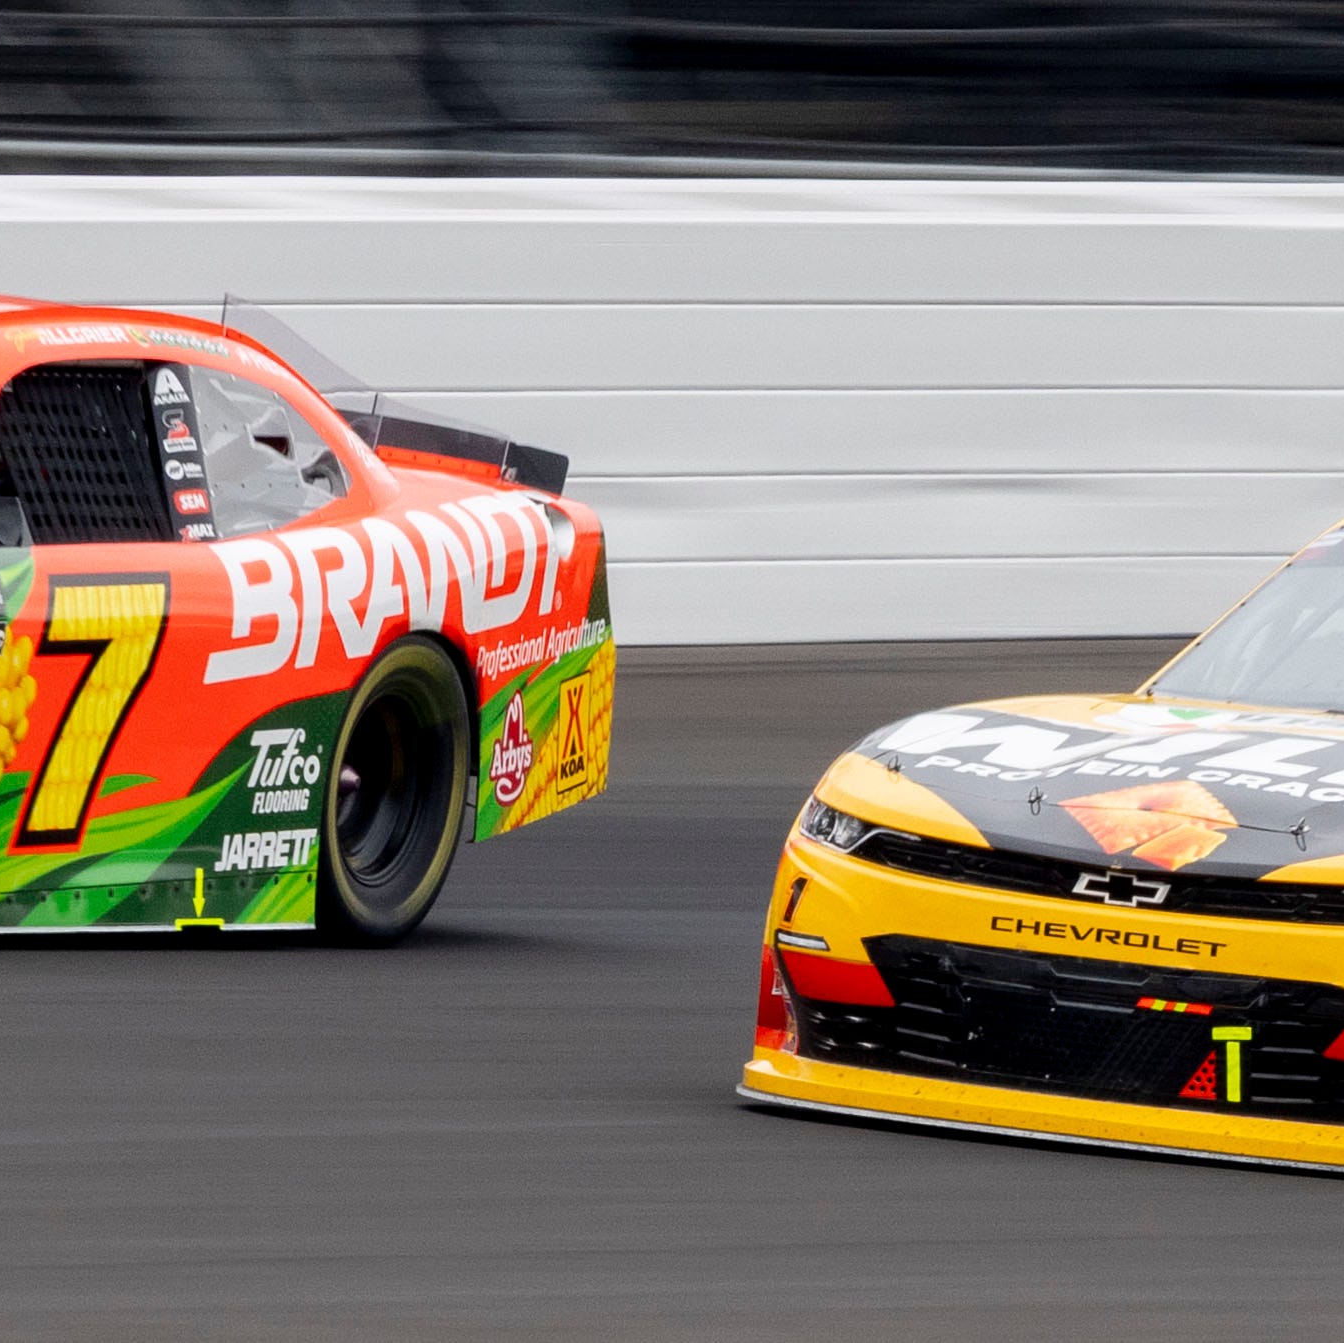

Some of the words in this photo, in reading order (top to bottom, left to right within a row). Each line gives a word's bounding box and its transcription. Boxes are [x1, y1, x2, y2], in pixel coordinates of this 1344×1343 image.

[179, 493, 206, 511] SEM
[203, 490, 561, 685] BRANDT
[477, 628, 545, 681] Professional
[546, 618, 606, 663] Agriculture
[11, 570, 171, 849] 7
[247, 728, 320, 787] Tufco
[560, 756, 585, 780] KOA
[252, 788, 310, 814] FLOORING
[214, 828, 317, 871] JARRETT
[782, 875, 808, 923] 1
[991, 916, 1227, 957] CHEVROLET
